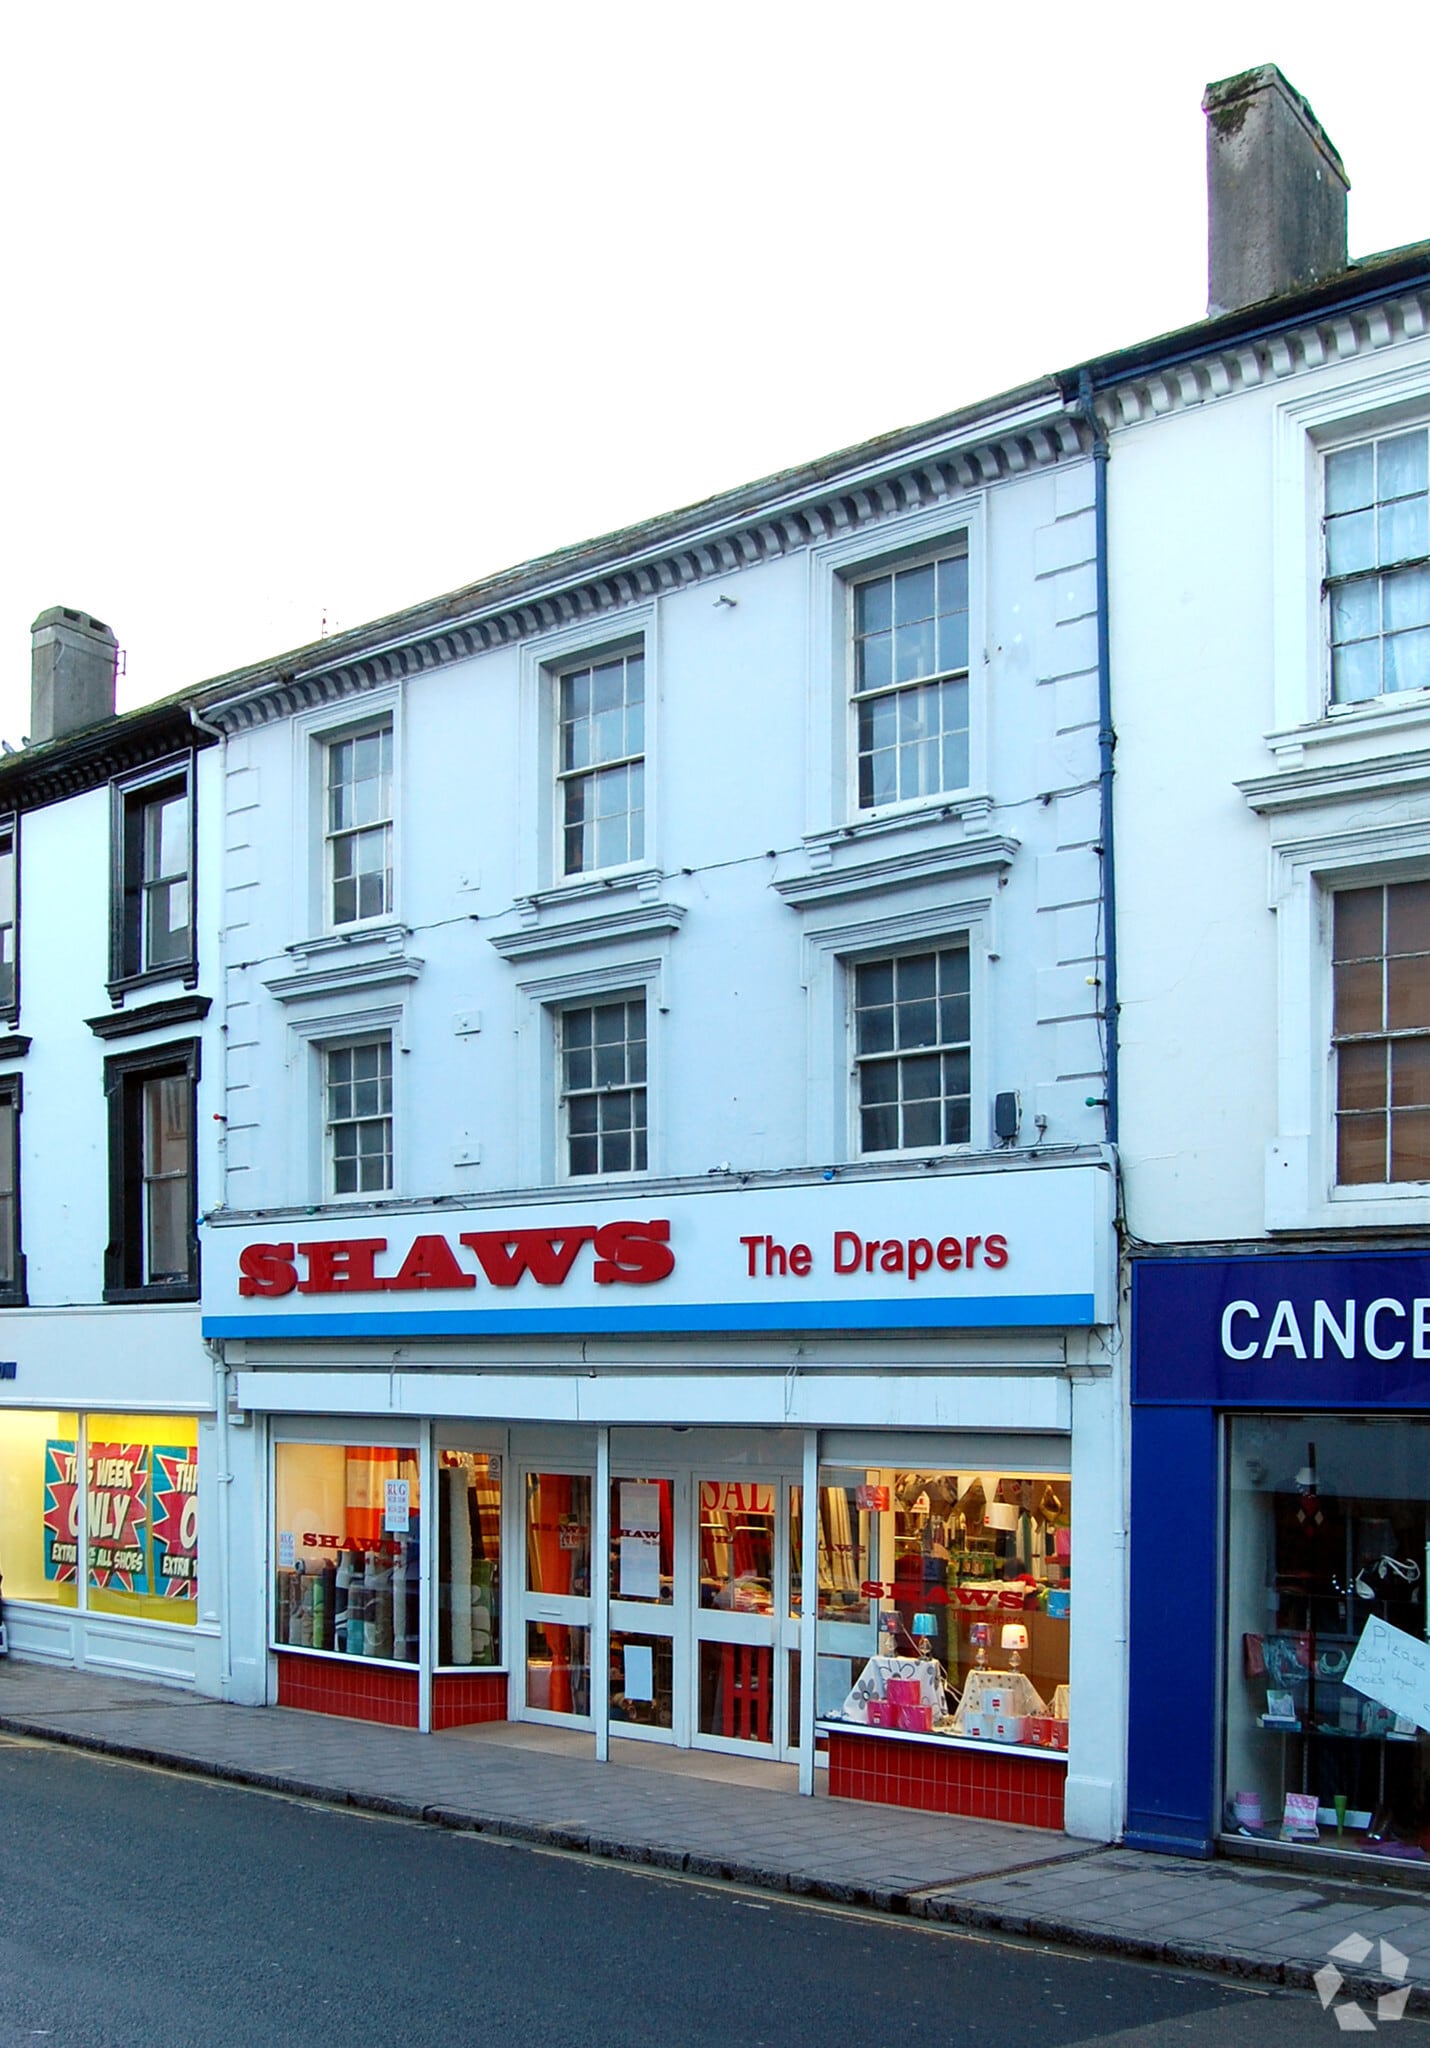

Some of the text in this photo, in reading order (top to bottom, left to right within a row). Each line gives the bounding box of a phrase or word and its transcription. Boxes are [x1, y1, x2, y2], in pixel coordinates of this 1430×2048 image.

[239, 1219, 675, 1298] SHAWS
[739, 1231, 1009, 1280] The Drapers
[96, 1457, 134, 1488] WEEK
[387, 1483, 406, 1496] RUG
[96, 1549, 112, 1566] ALL
[114, 1550, 143, 1572] SHOES
[162, 1556, 188, 1577] EXTRA
[861, 1580, 1025, 1610] SHAWS
[1372, 1624, 1427, 1671] Please
